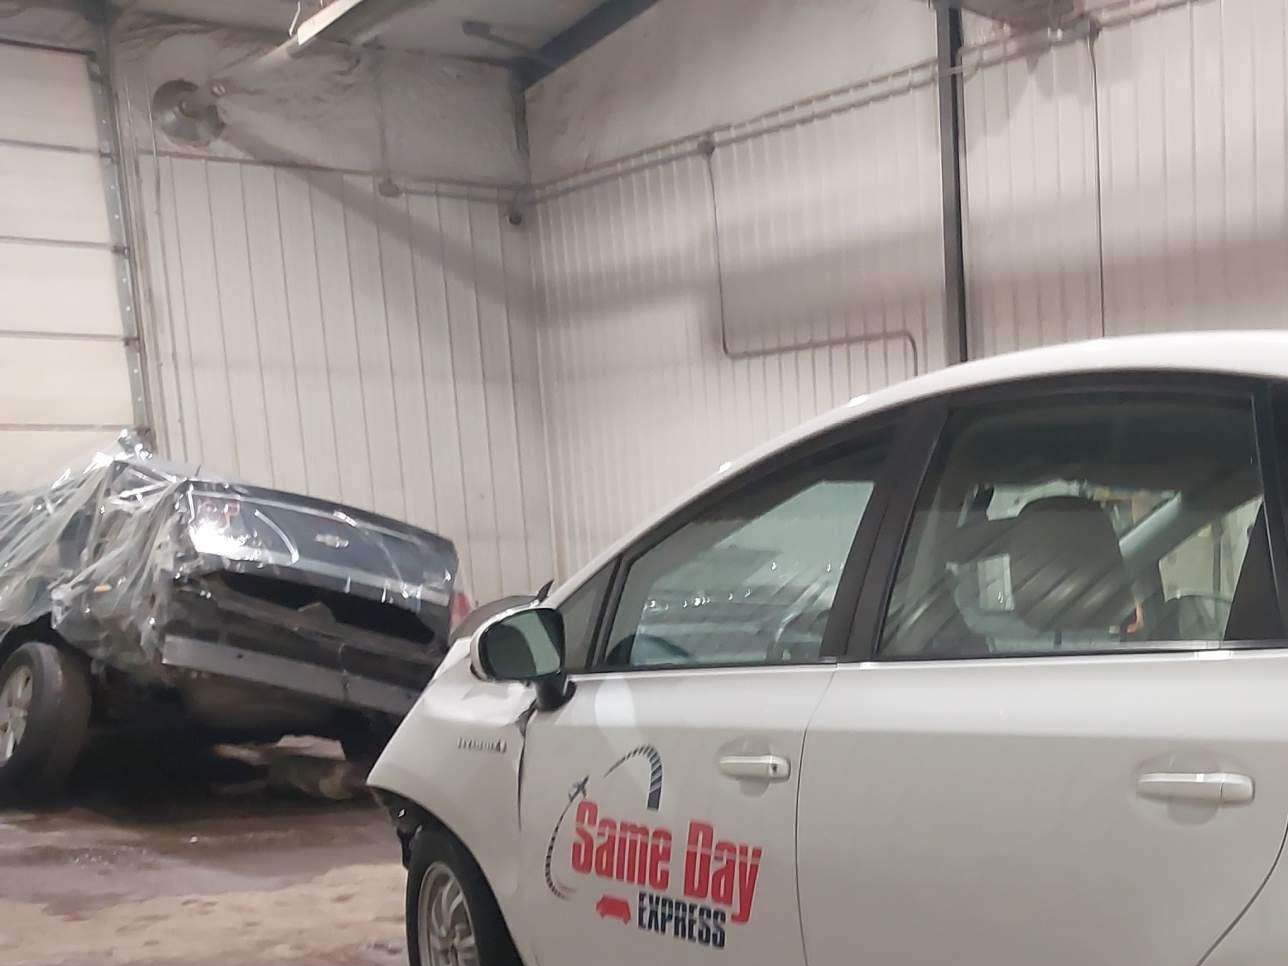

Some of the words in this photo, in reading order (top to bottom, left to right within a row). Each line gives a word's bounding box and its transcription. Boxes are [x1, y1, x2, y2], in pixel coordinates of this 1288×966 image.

[571, 800, 673, 891] Same
[684, 819, 763, 925] Day
[637, 891, 727, 949] EXPRESS
